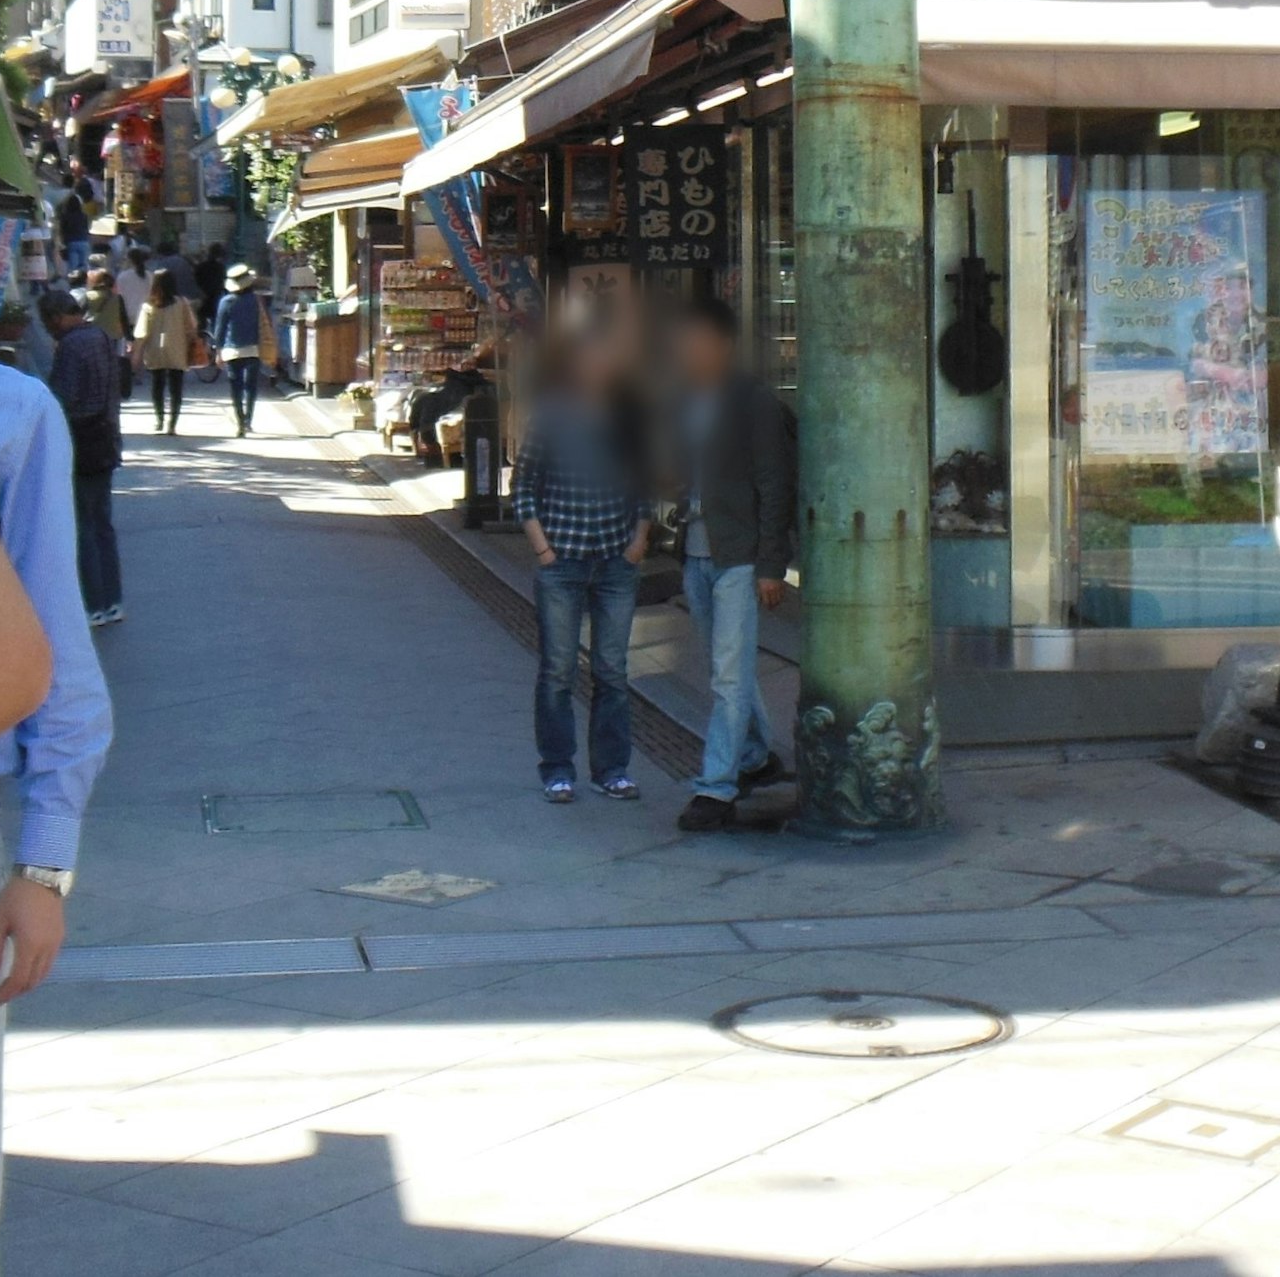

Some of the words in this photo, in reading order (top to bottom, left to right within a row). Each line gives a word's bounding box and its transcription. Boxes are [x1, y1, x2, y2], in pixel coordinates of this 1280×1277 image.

[677, 146, 716, 236] ひもの
[648, 242, 710, 262] 丸だい
